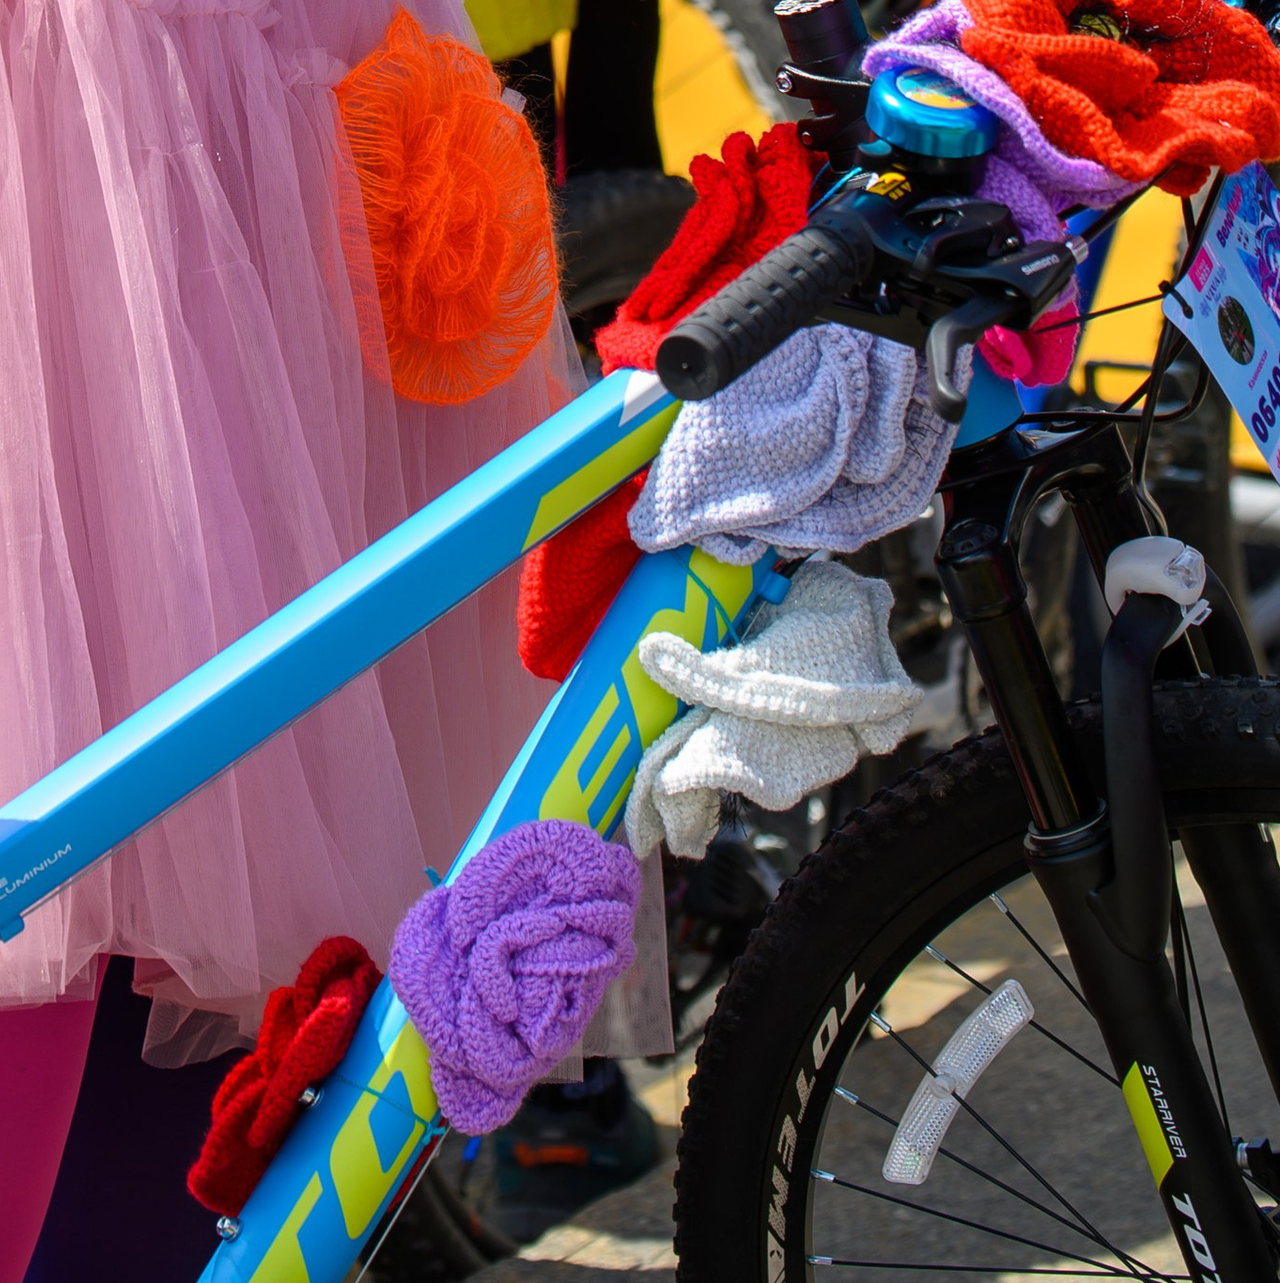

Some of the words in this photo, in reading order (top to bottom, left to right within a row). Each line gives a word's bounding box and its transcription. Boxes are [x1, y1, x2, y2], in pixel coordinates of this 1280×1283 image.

[249, 545, 753, 1283] TOEM
[768, 972, 866, 1241] TOTEM
[1142, 1065, 1188, 1159] STARRIVER
[1172, 1192, 1222, 1283] TO
